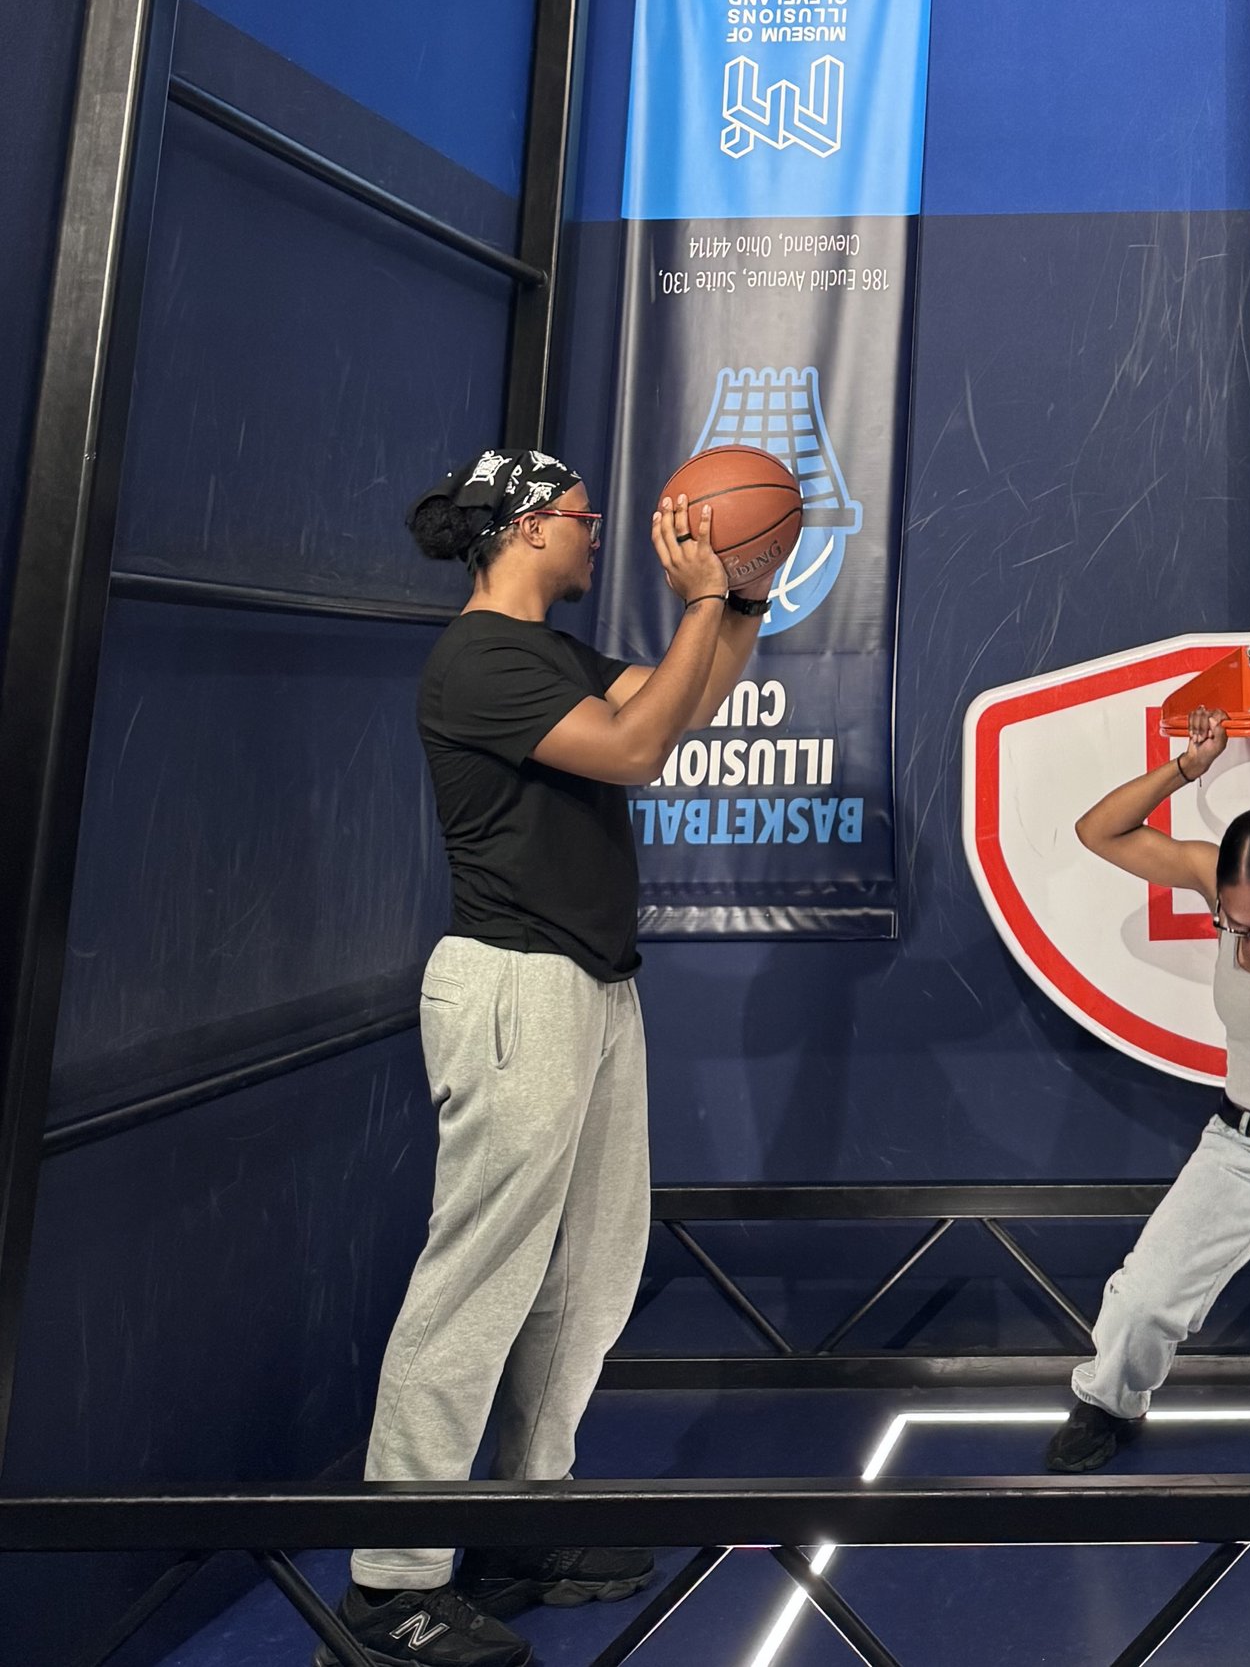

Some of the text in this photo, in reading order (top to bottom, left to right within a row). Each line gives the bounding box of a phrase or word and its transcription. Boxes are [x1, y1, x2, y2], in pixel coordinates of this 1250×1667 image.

[728, 8, 847, 24] ILLUSIONS
[726, 26, 846, 43] MUSEUM OF
[689, 233, 860, 258] Cleveland, Ohio 44114
[658, 268, 889, 294] 186 Euclid Avenue, Suite 130,
[727, 539, 782, 579] LDING
[628, 797, 864, 845] BASKETBAL
